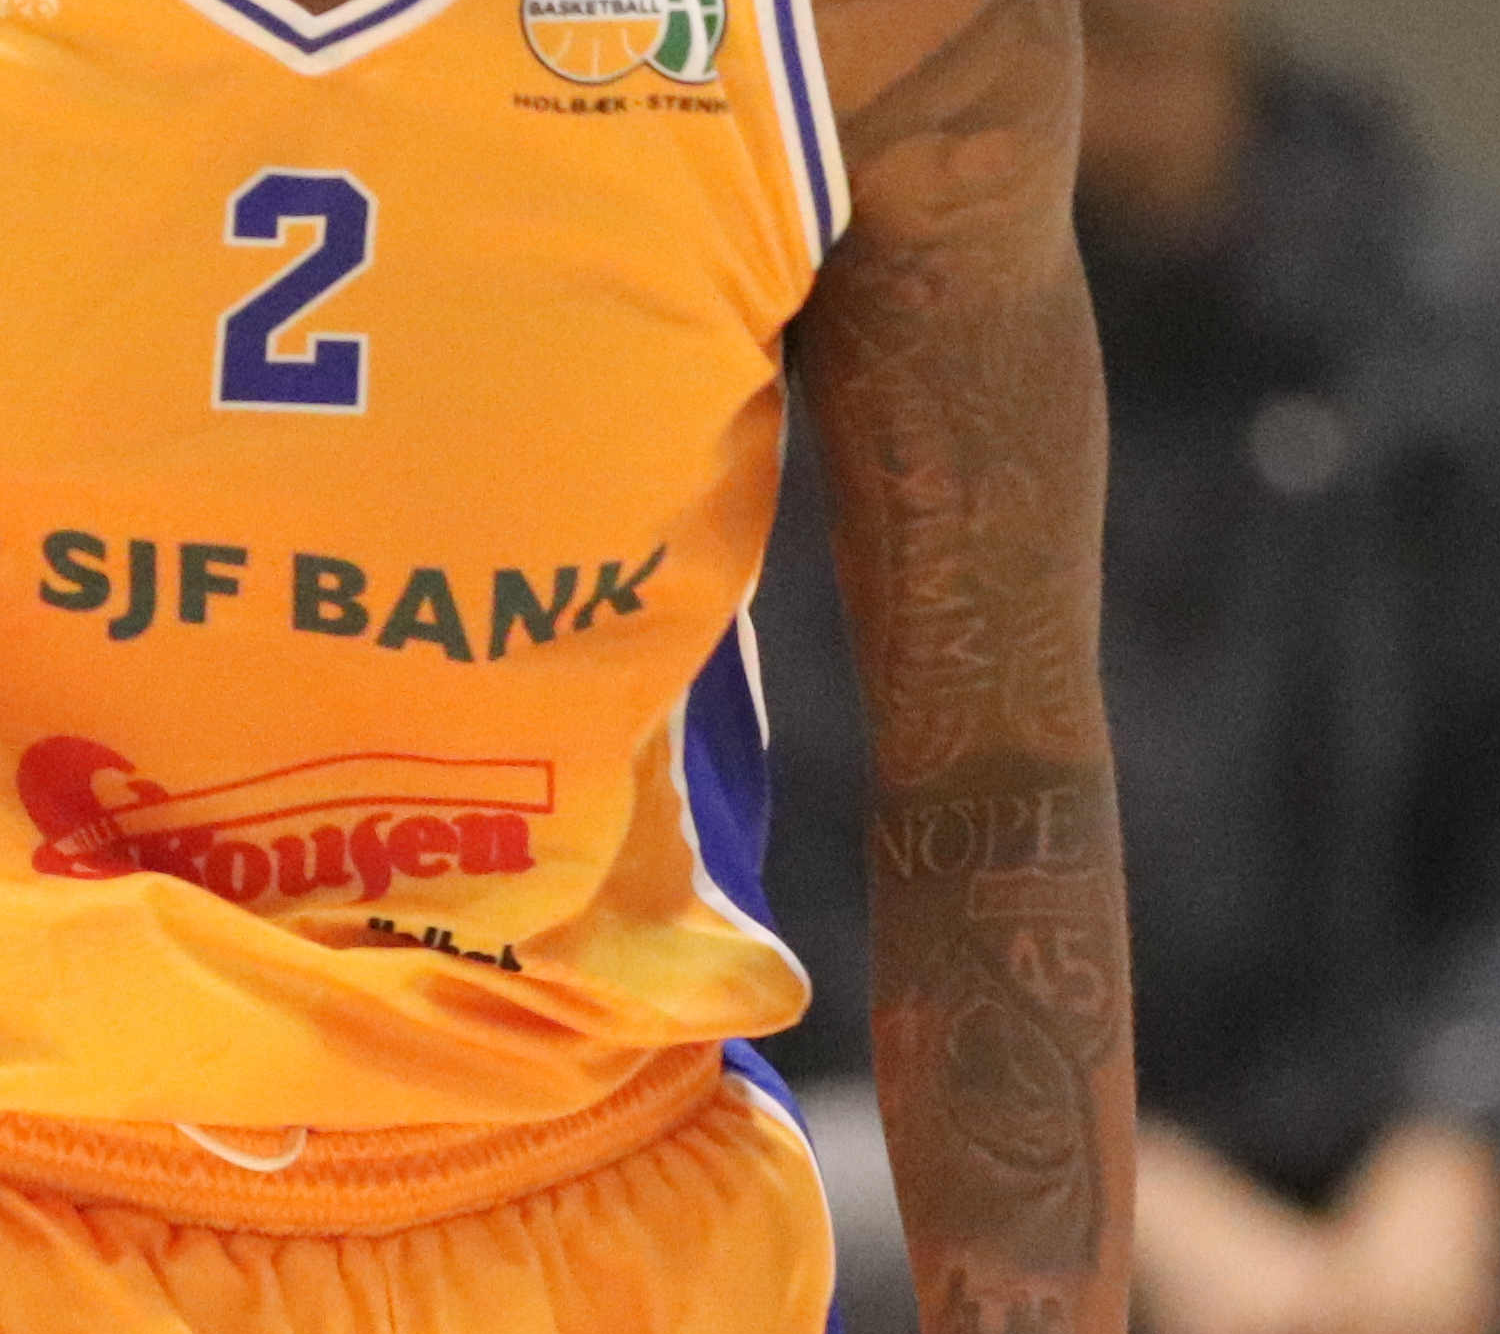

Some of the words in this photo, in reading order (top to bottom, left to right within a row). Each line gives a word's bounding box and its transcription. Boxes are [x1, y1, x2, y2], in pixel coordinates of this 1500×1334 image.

[212, 165, 378, 414] 2
[38, 528, 248, 641] SJF
[292, 543, 669, 663] BANK
